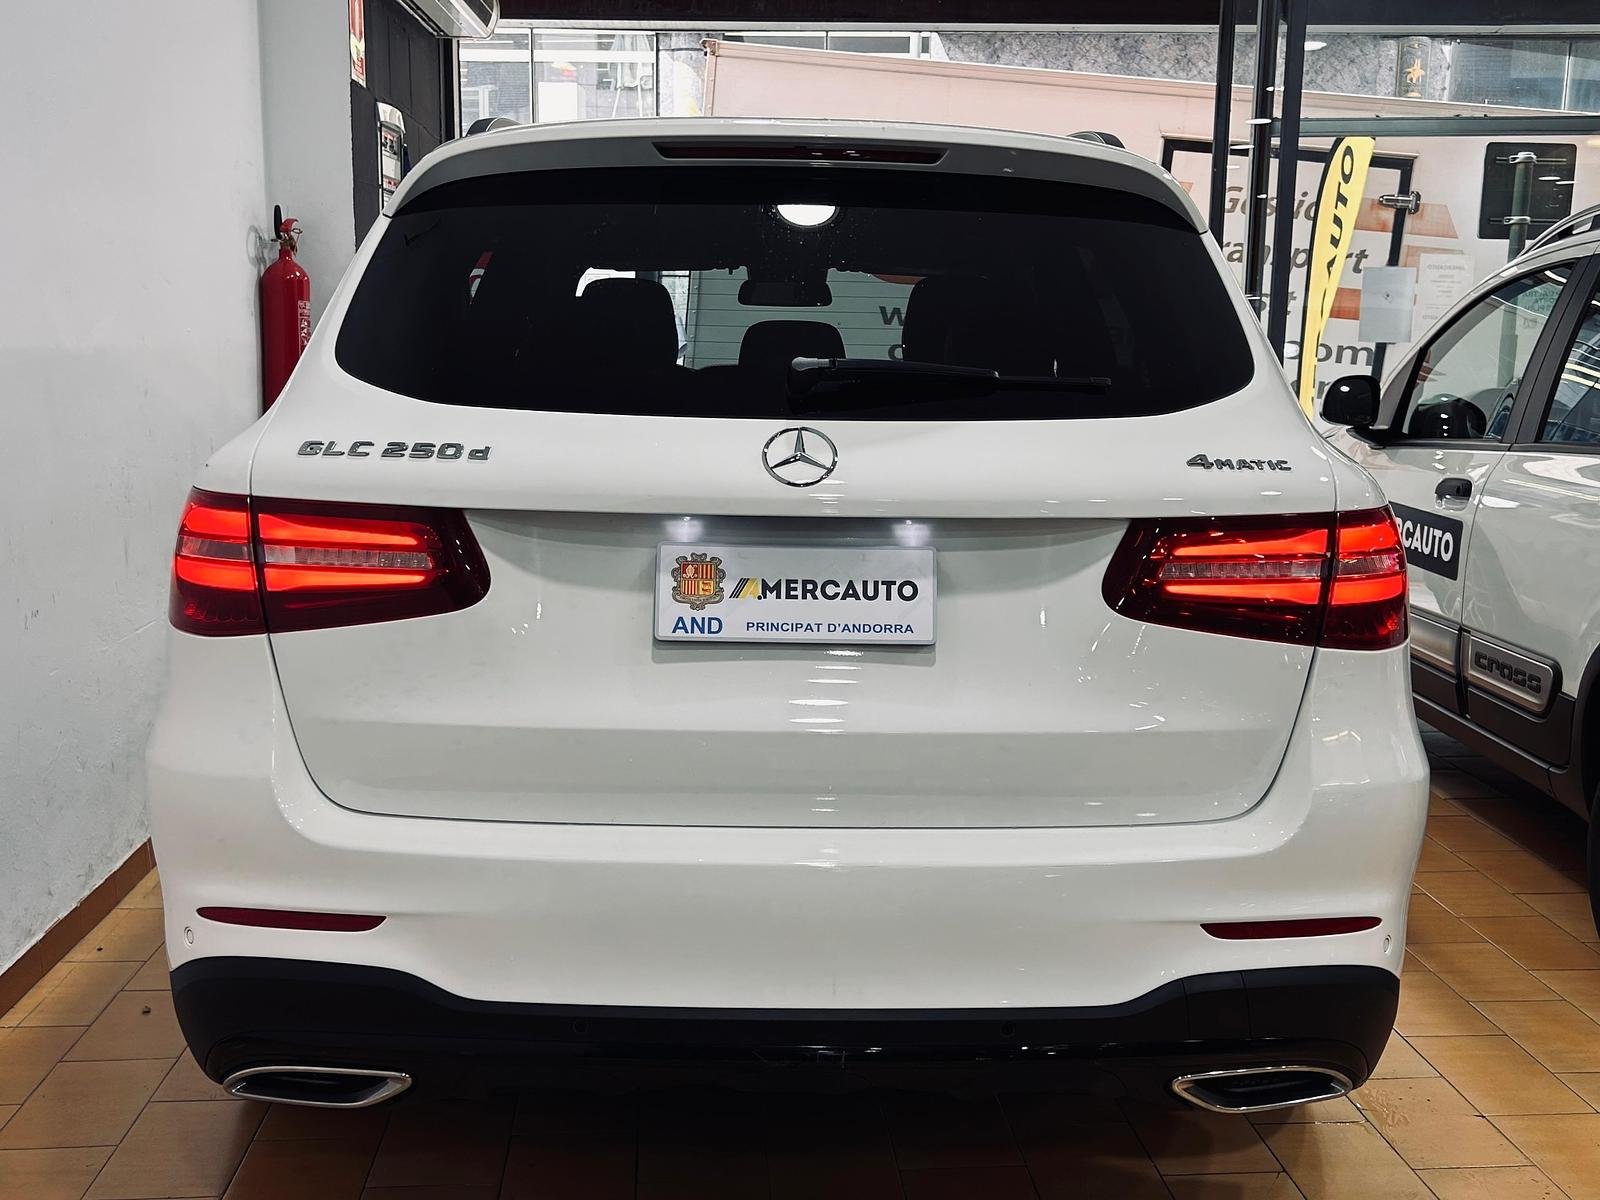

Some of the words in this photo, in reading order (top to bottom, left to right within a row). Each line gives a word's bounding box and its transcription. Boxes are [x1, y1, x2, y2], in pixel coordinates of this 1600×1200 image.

[298, 440, 374, 457] GLC
[381, 441, 464, 460] 250
[467, 446, 492, 461] d
[1186, 453, 1292, 471] 4MATIC
[761, 578, 919, 602] MERCAUTO
[671, 616, 723, 635] AND
[746, 621, 822, 634] PRINCIPAT
[827, 622, 914, 635] D'ANDORRA
